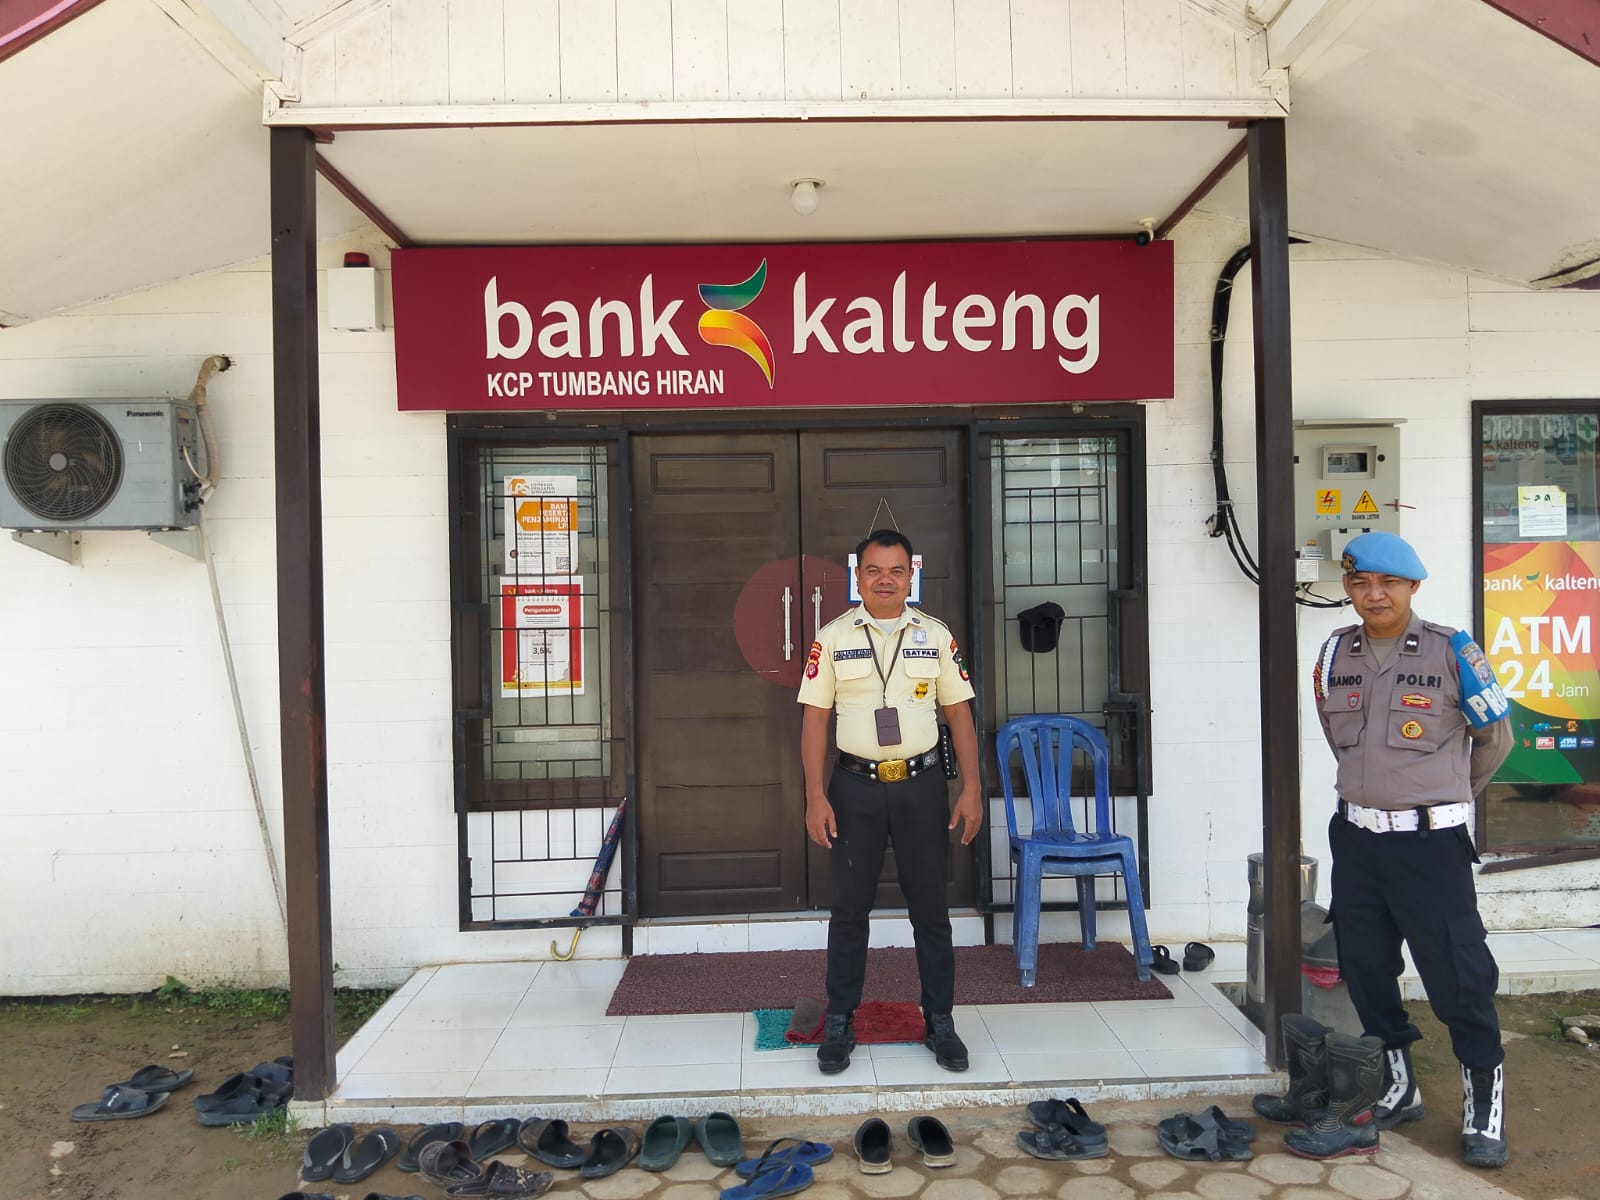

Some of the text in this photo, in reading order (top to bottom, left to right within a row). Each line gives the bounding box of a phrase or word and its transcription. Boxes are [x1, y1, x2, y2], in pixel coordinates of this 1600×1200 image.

[484, 270, 1100, 374] bank kalteng
[487, 369, 724, 397] KCP TUMBANG HIRAN
[1545, 572, 1600, 592] kalten
[1489, 615, 1591, 655] ATM
[1396, 673, 1442, 689] POLRI
[1498, 659, 1589, 698] 24 Jam
